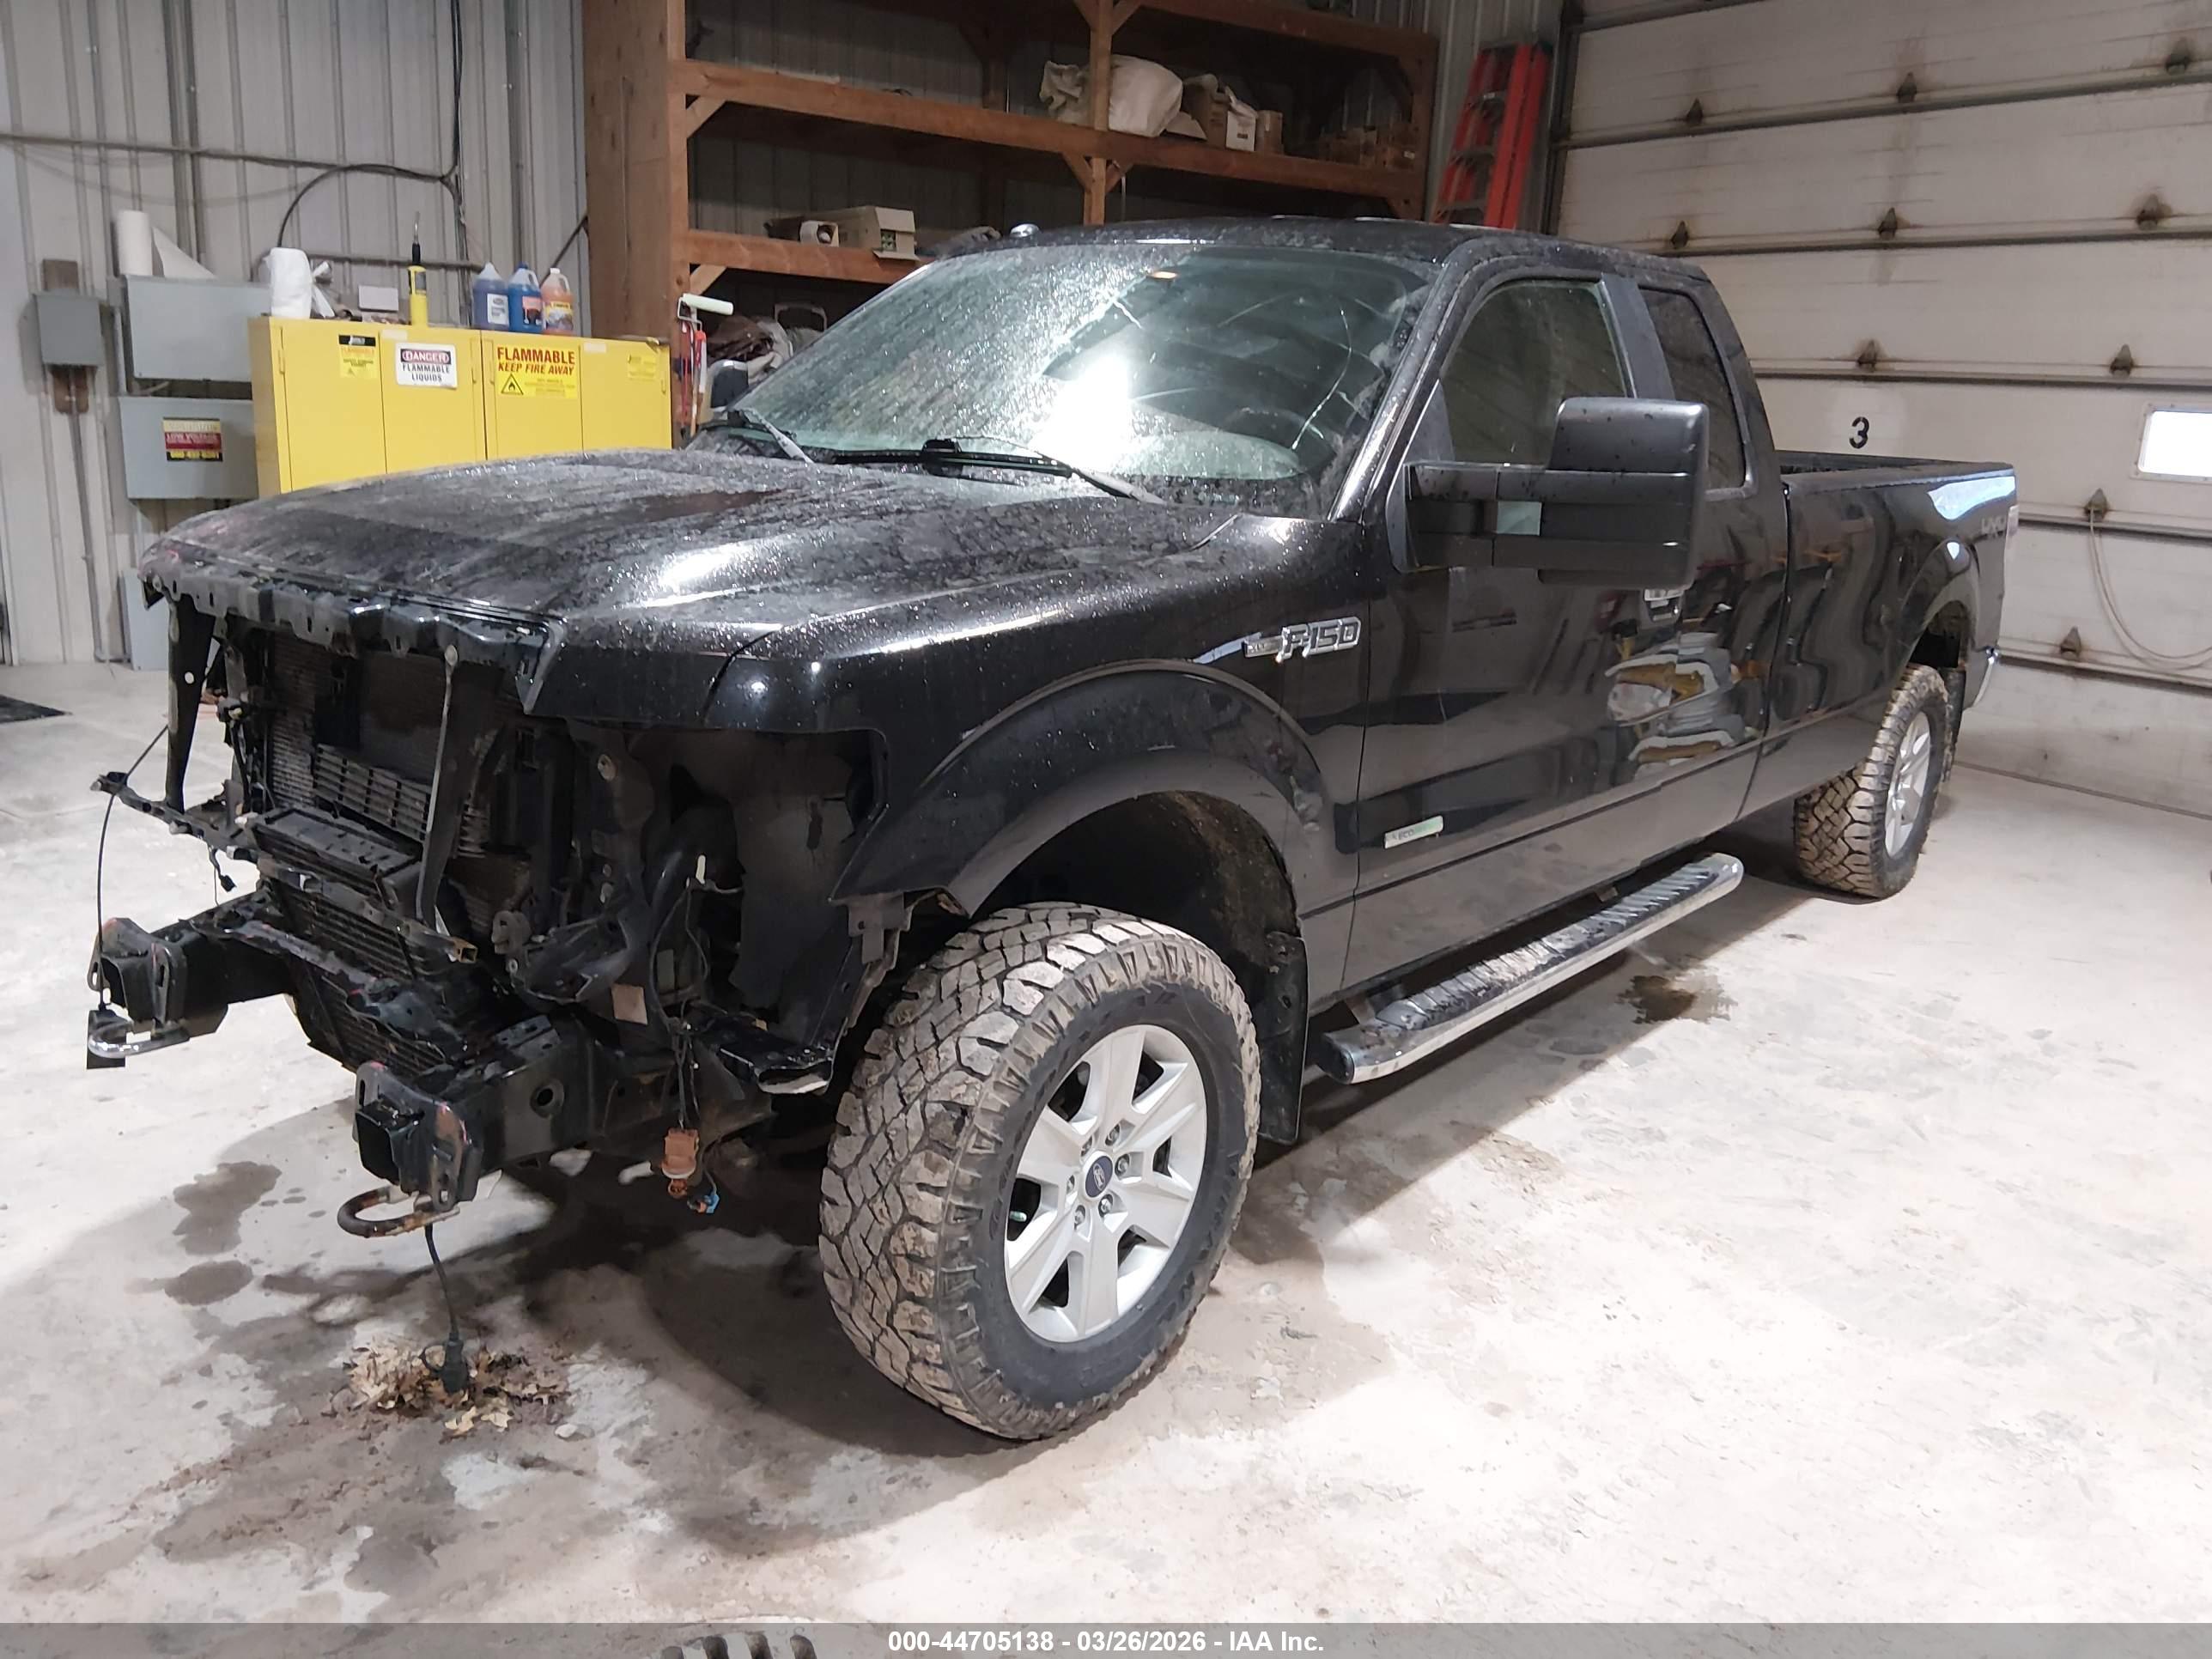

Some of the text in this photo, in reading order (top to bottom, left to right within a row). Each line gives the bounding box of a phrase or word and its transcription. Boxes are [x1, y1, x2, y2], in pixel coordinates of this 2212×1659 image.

[405, 350, 447, 363] DANGER
[497, 347, 575, 365] FLAMMABLE
[403, 362, 449, 374] FLAMMABLE
[498, 362, 574, 376] KEEP FIRE AWAY
[411, 372, 442, 383] LIQUIDS
[1849, 416, 1870, 449] 3
